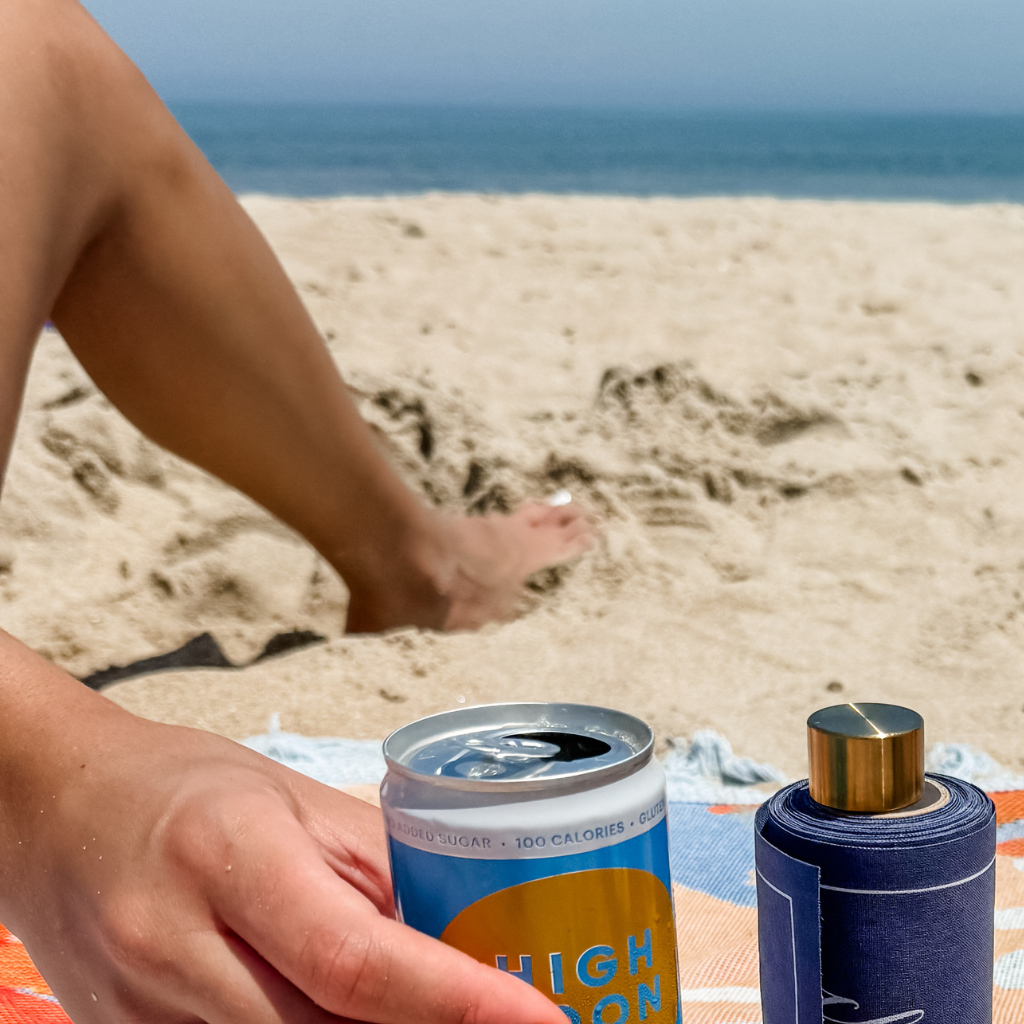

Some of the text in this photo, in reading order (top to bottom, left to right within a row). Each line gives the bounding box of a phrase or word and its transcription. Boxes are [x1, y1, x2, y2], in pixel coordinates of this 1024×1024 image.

[438, 833, 491, 849] SUGAR
[515, 821, 625, 849] 100 CALORIES
[495, 928, 652, 994] HIGH
